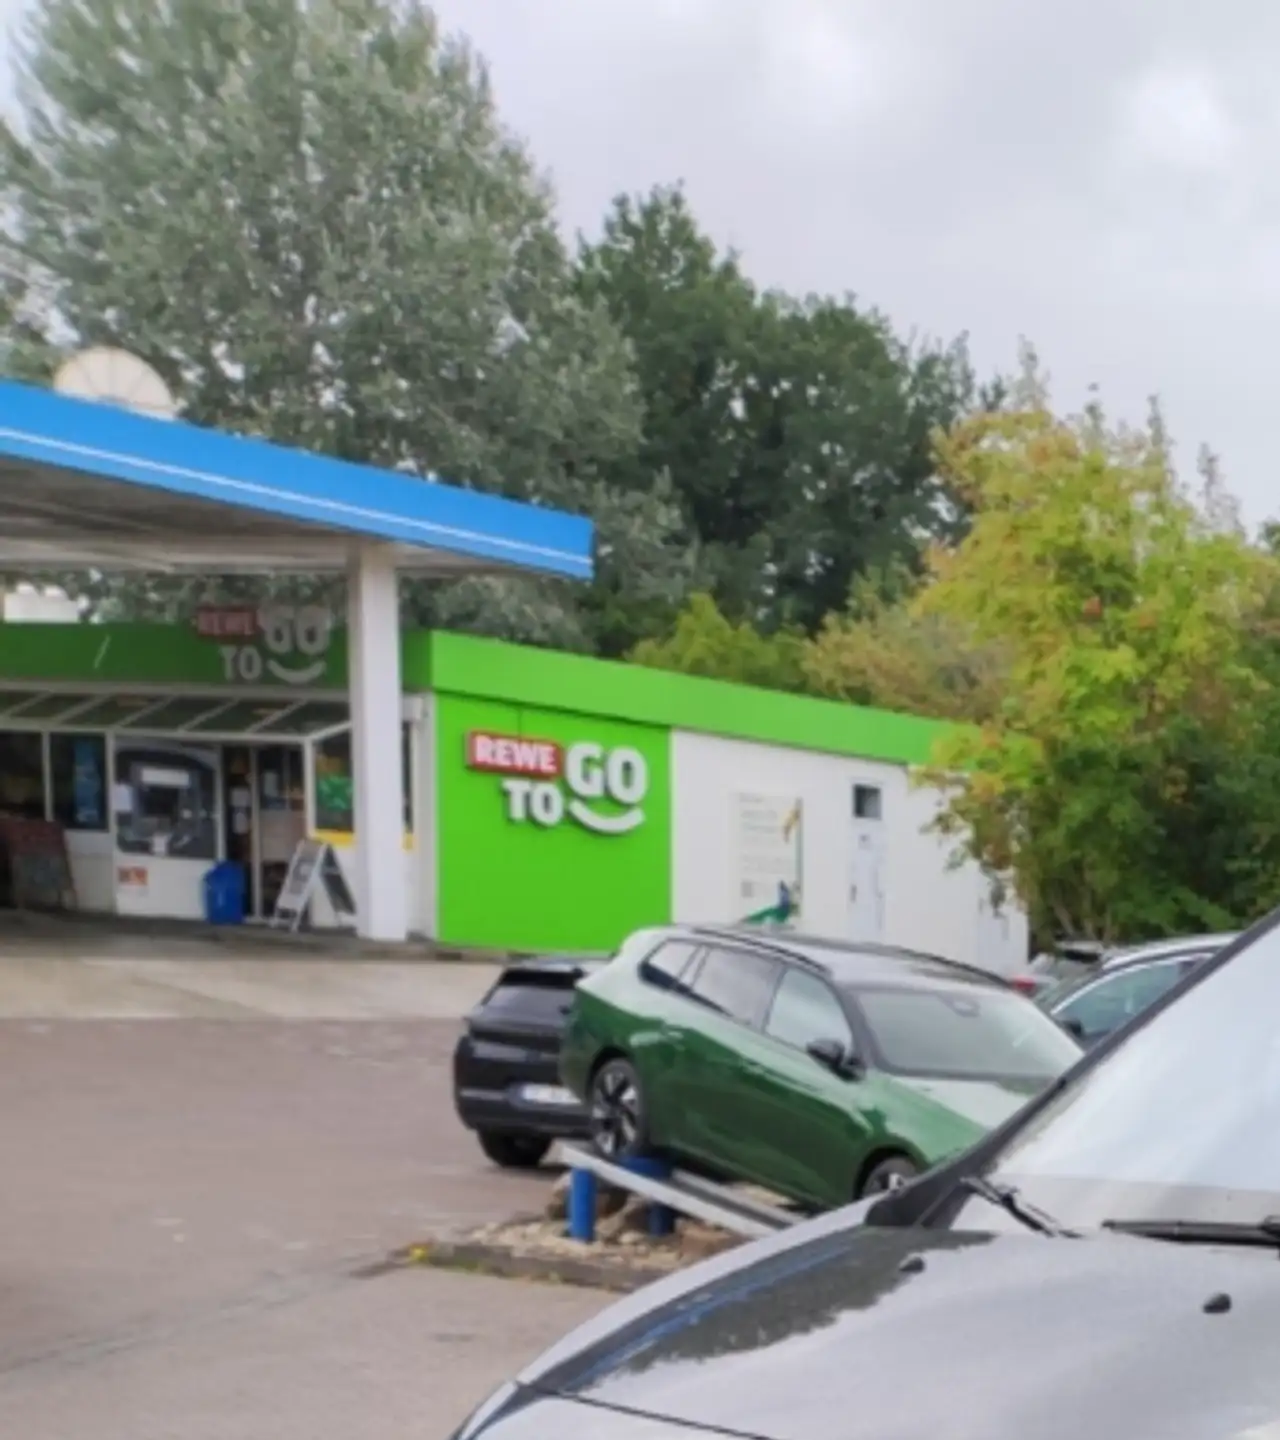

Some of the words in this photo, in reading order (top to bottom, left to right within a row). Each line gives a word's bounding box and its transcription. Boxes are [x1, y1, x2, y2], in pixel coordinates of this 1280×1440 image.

[219, 644, 262, 680] TO
[474, 734, 558, 774] REWE
[565, 742, 648, 804] GO
[501, 779, 564, 825] TO
